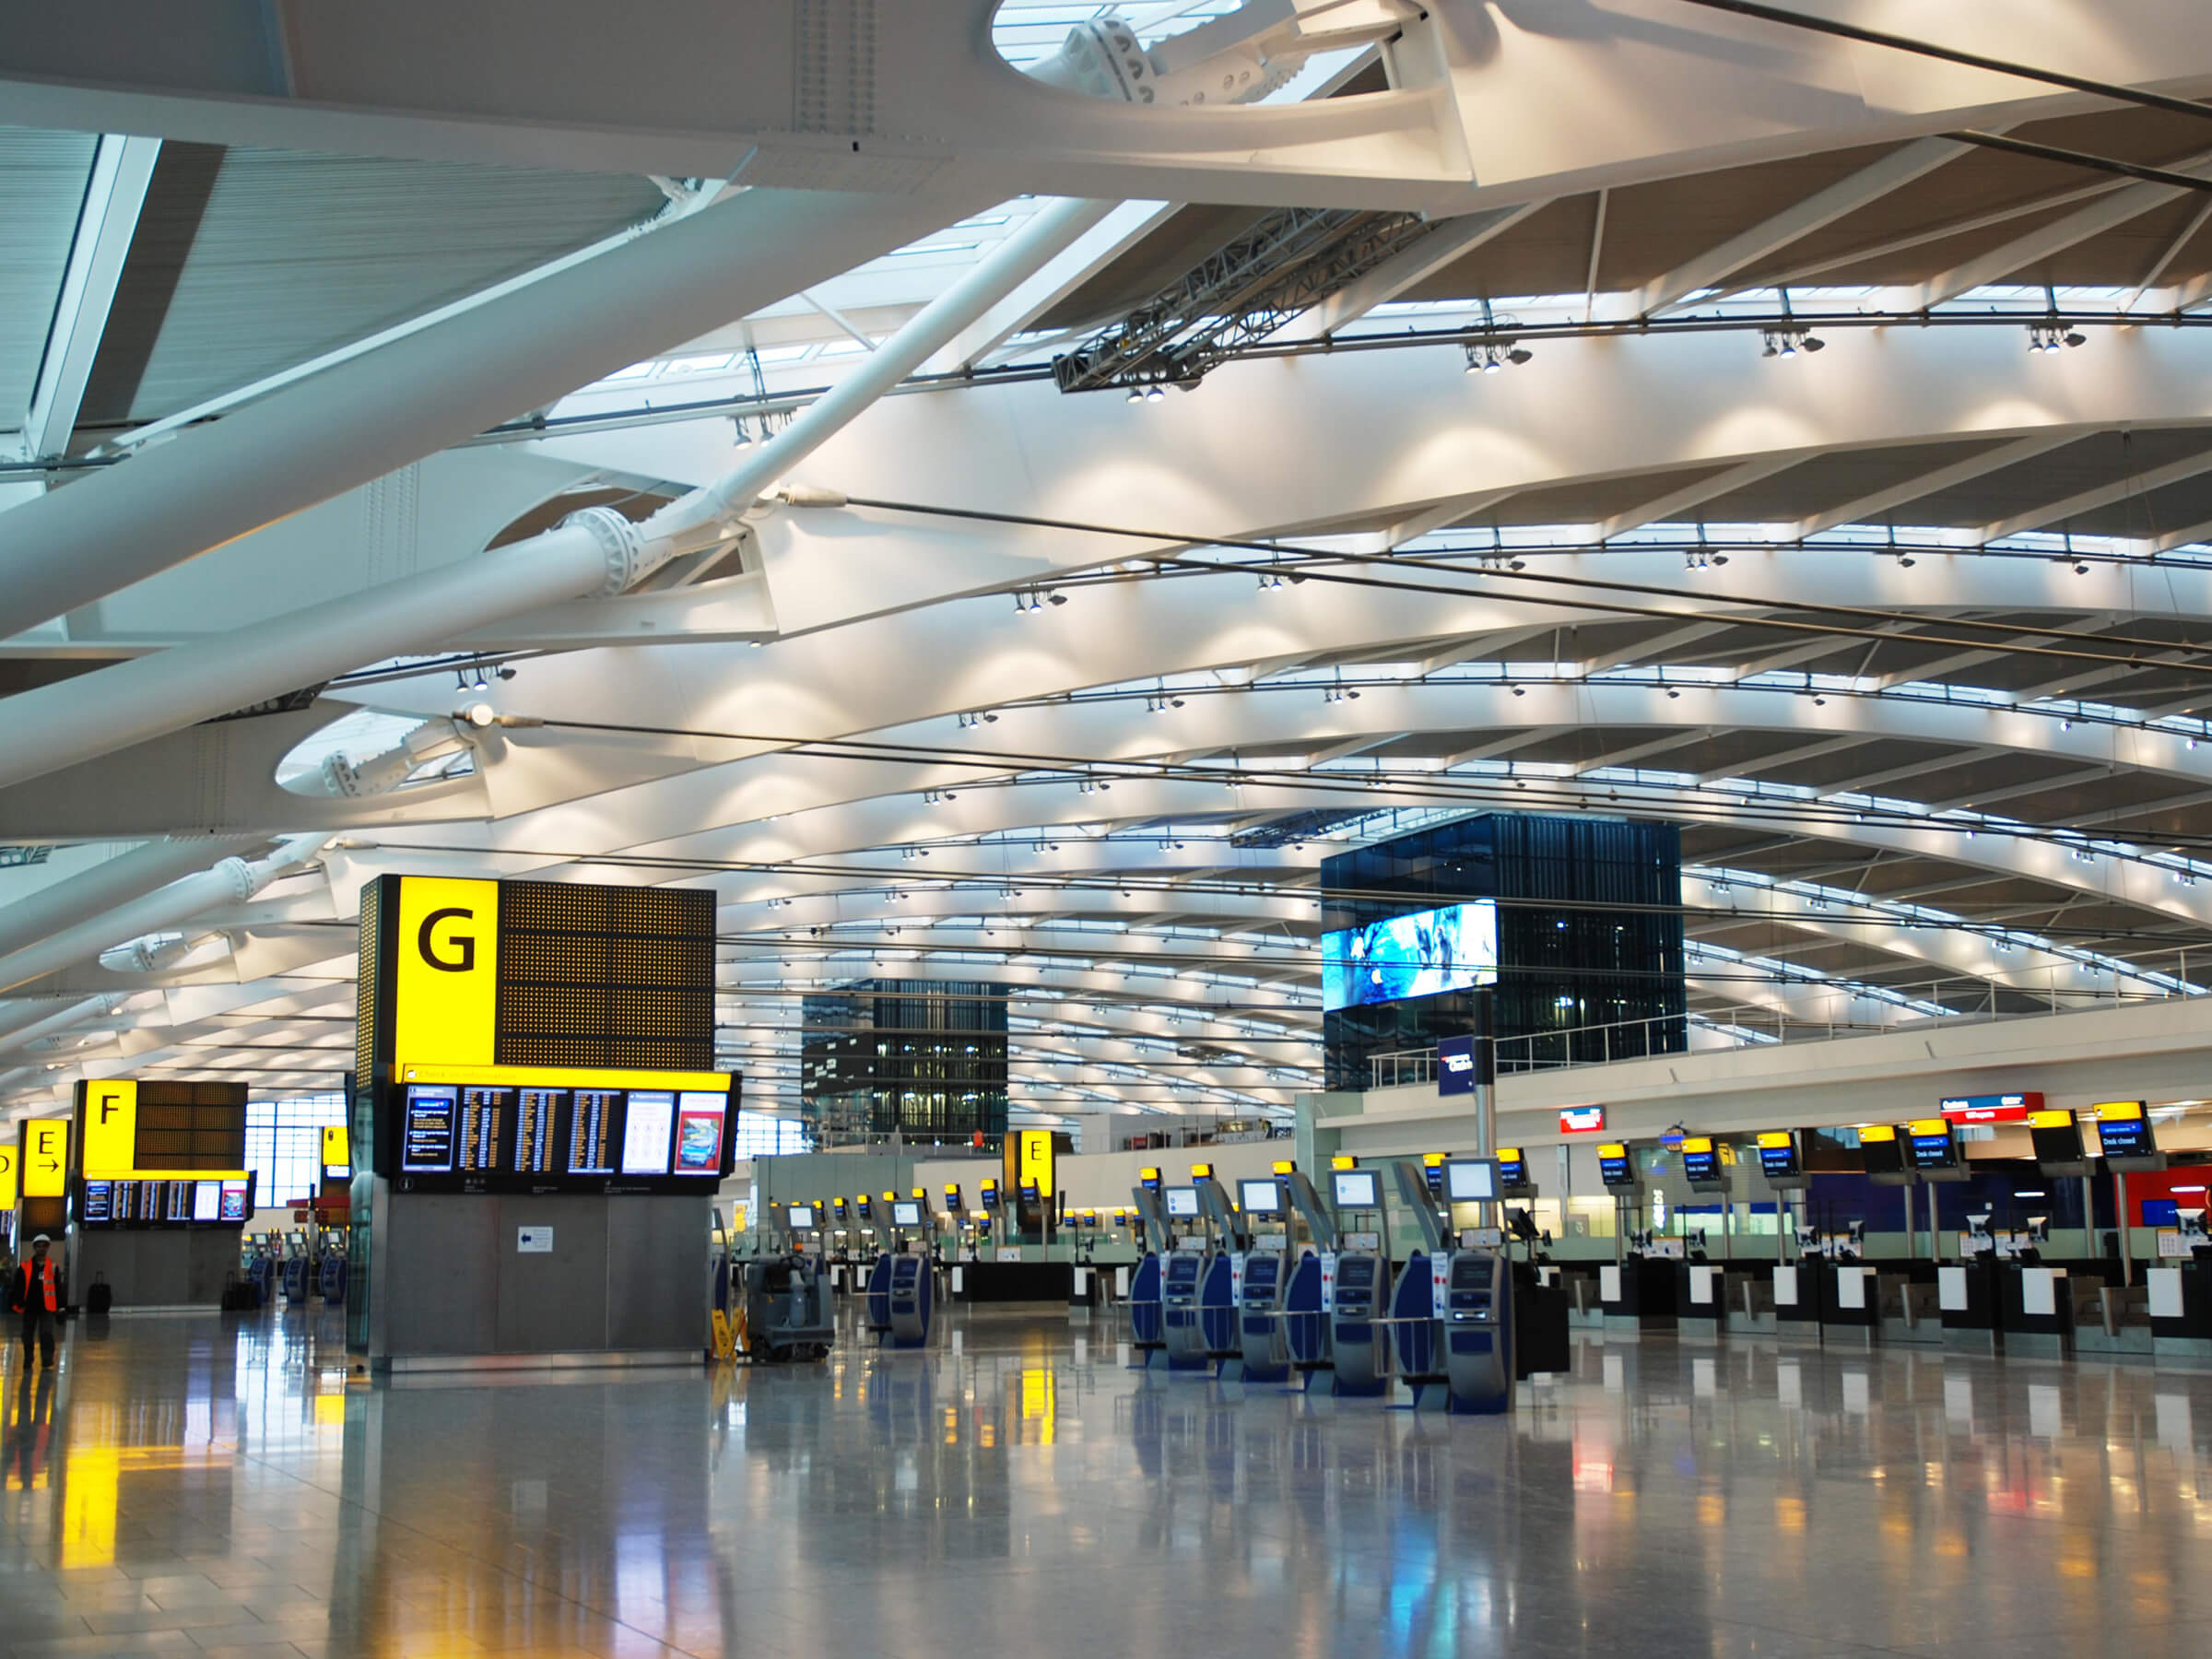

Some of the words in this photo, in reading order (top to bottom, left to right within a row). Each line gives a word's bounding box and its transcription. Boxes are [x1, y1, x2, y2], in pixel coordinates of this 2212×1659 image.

[418, 907, 476, 972] G
[100, 1094, 121, 1124] F
[39, 1131, 54, 1154] E
[1030, 1140, 1042, 1160] E
